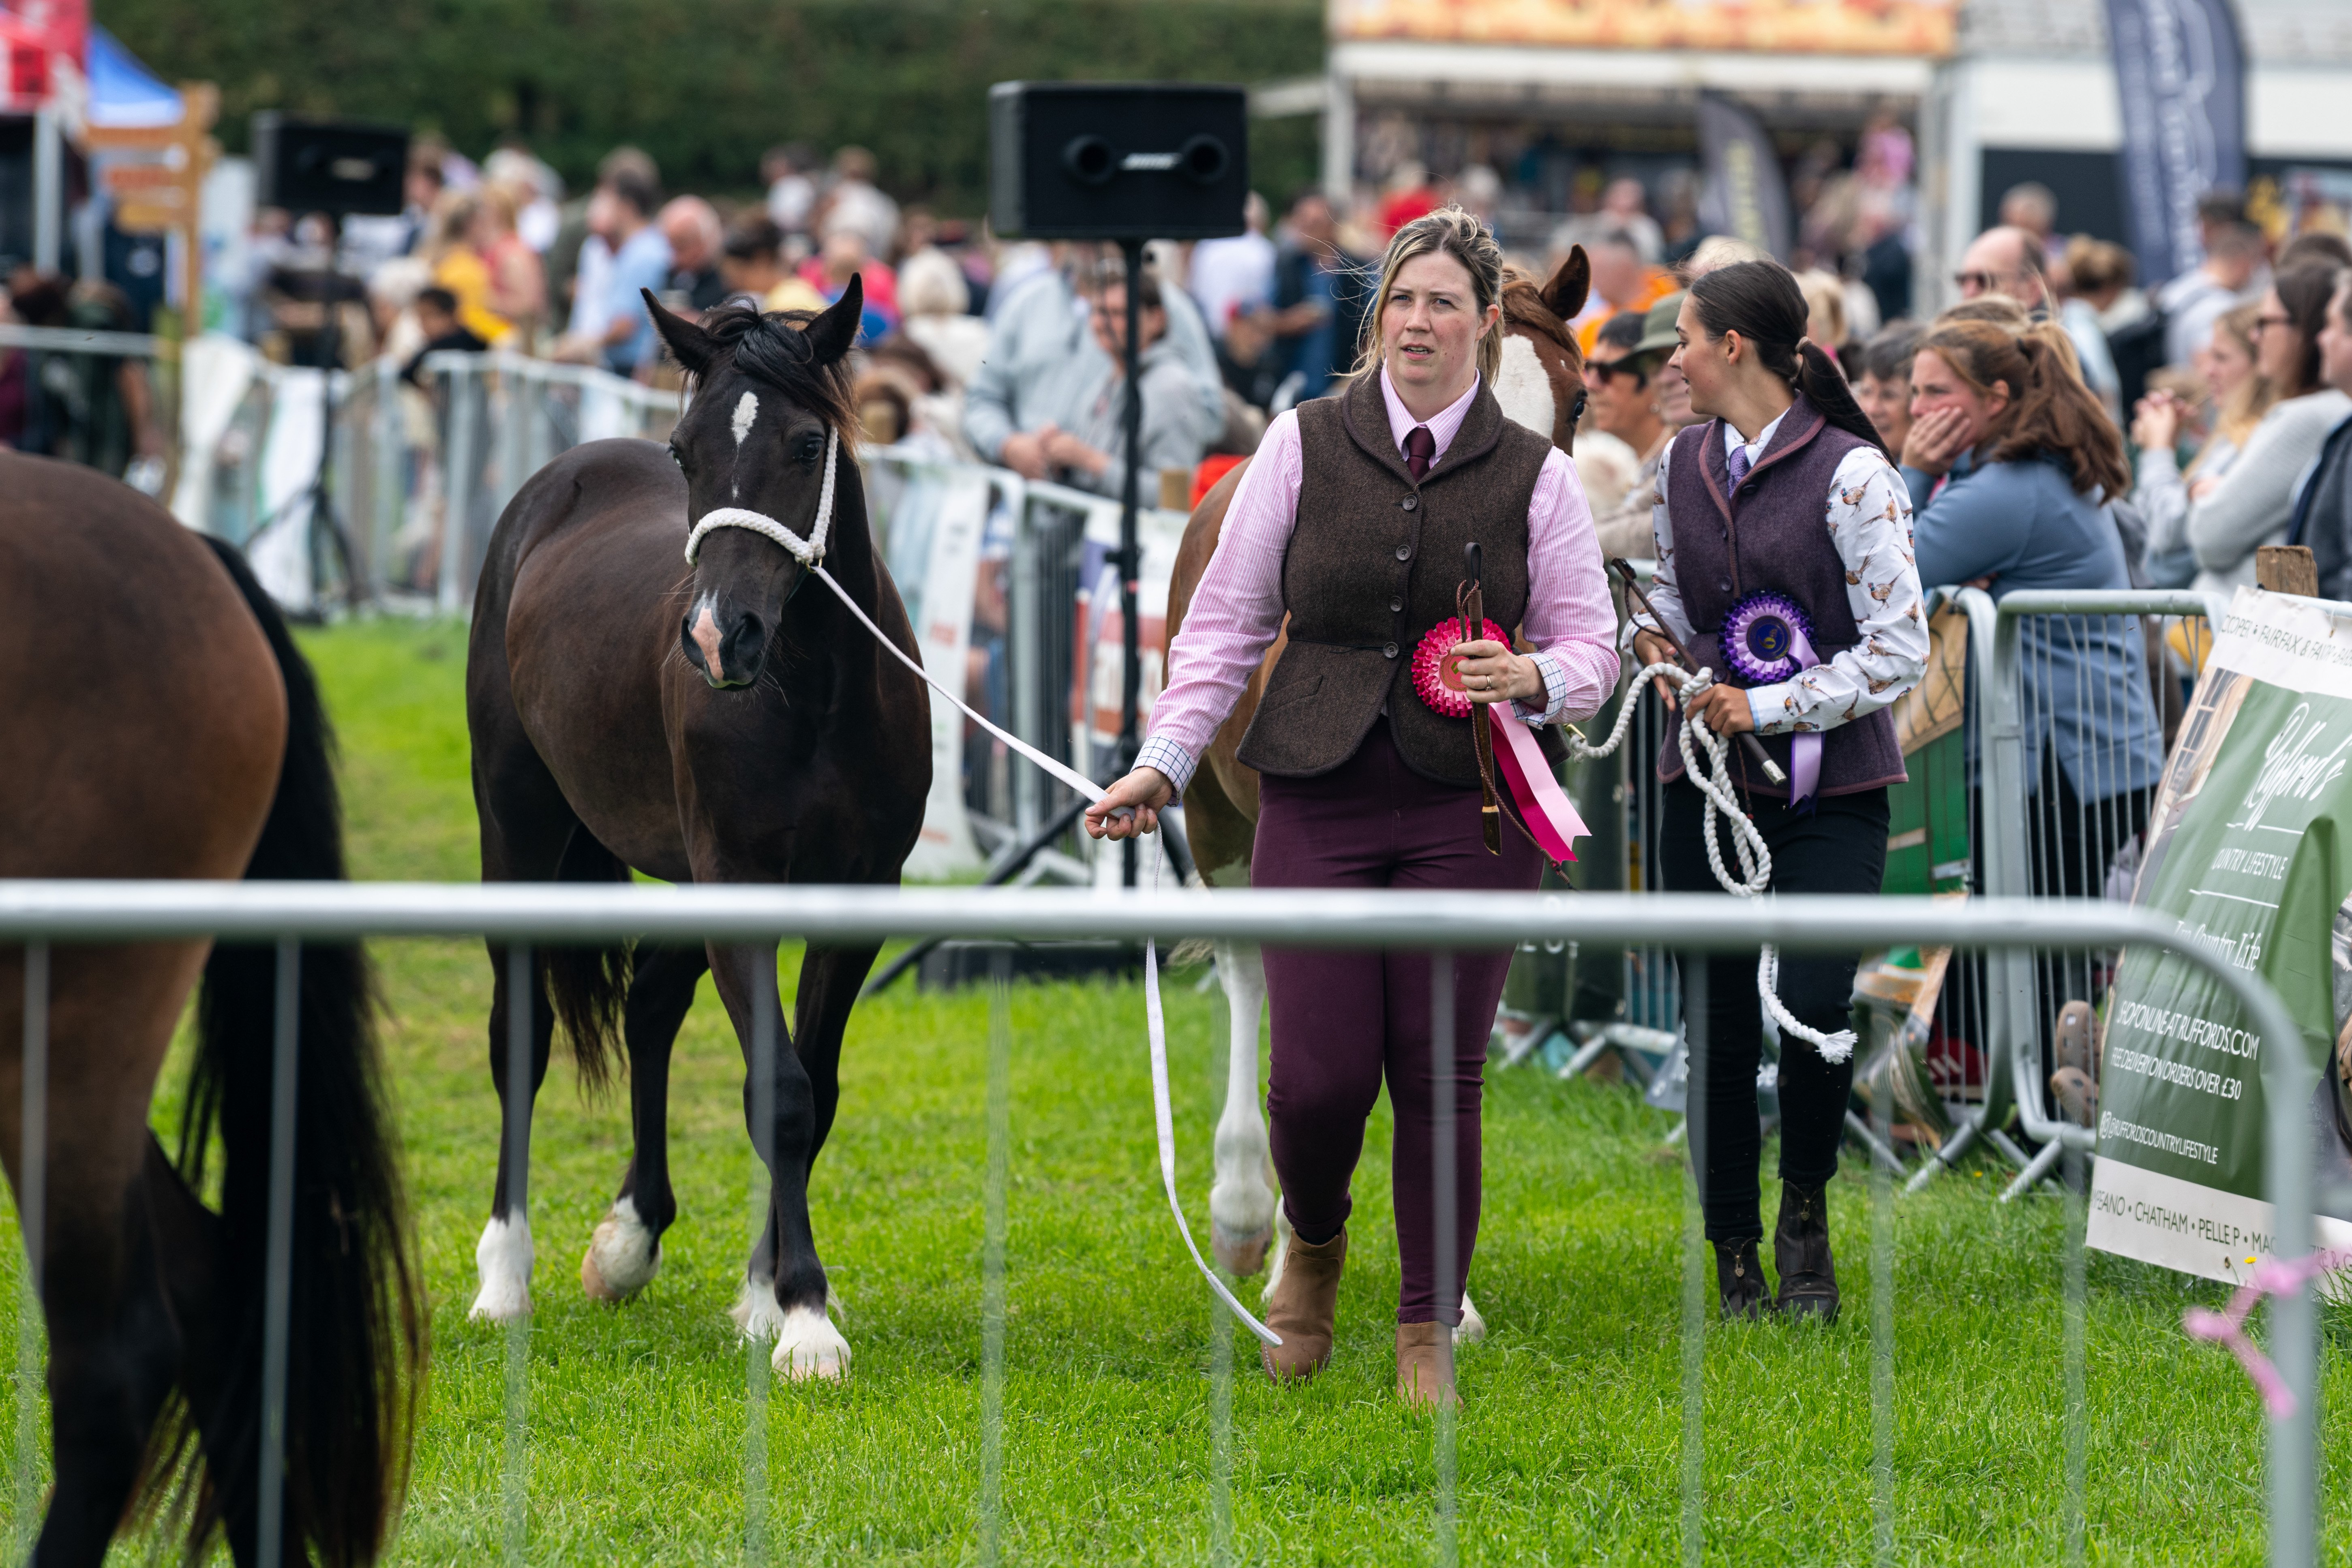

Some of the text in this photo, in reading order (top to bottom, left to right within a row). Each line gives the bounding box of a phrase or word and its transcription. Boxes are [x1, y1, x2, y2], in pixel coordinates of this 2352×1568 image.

[2258, 625, 2303, 654] FAIRFAX
[2300, 640, 2311, 657] &
[2242, 851, 2289, 880] LIFESTYLE
[2232, 932, 2262, 972] Life
[2116, 1000, 2260, 1061] SHOP ONLINE AT RUFFORDS.COM
[2111, 1047, 2242, 1100] FREE DELIVERY ON ORDERS OVER £30
[2135, 1201, 2188, 1234] CHATHAM
[2198, 1218, 2230, 1245] PELLE
[2233, 1227, 2241, 1247] P
